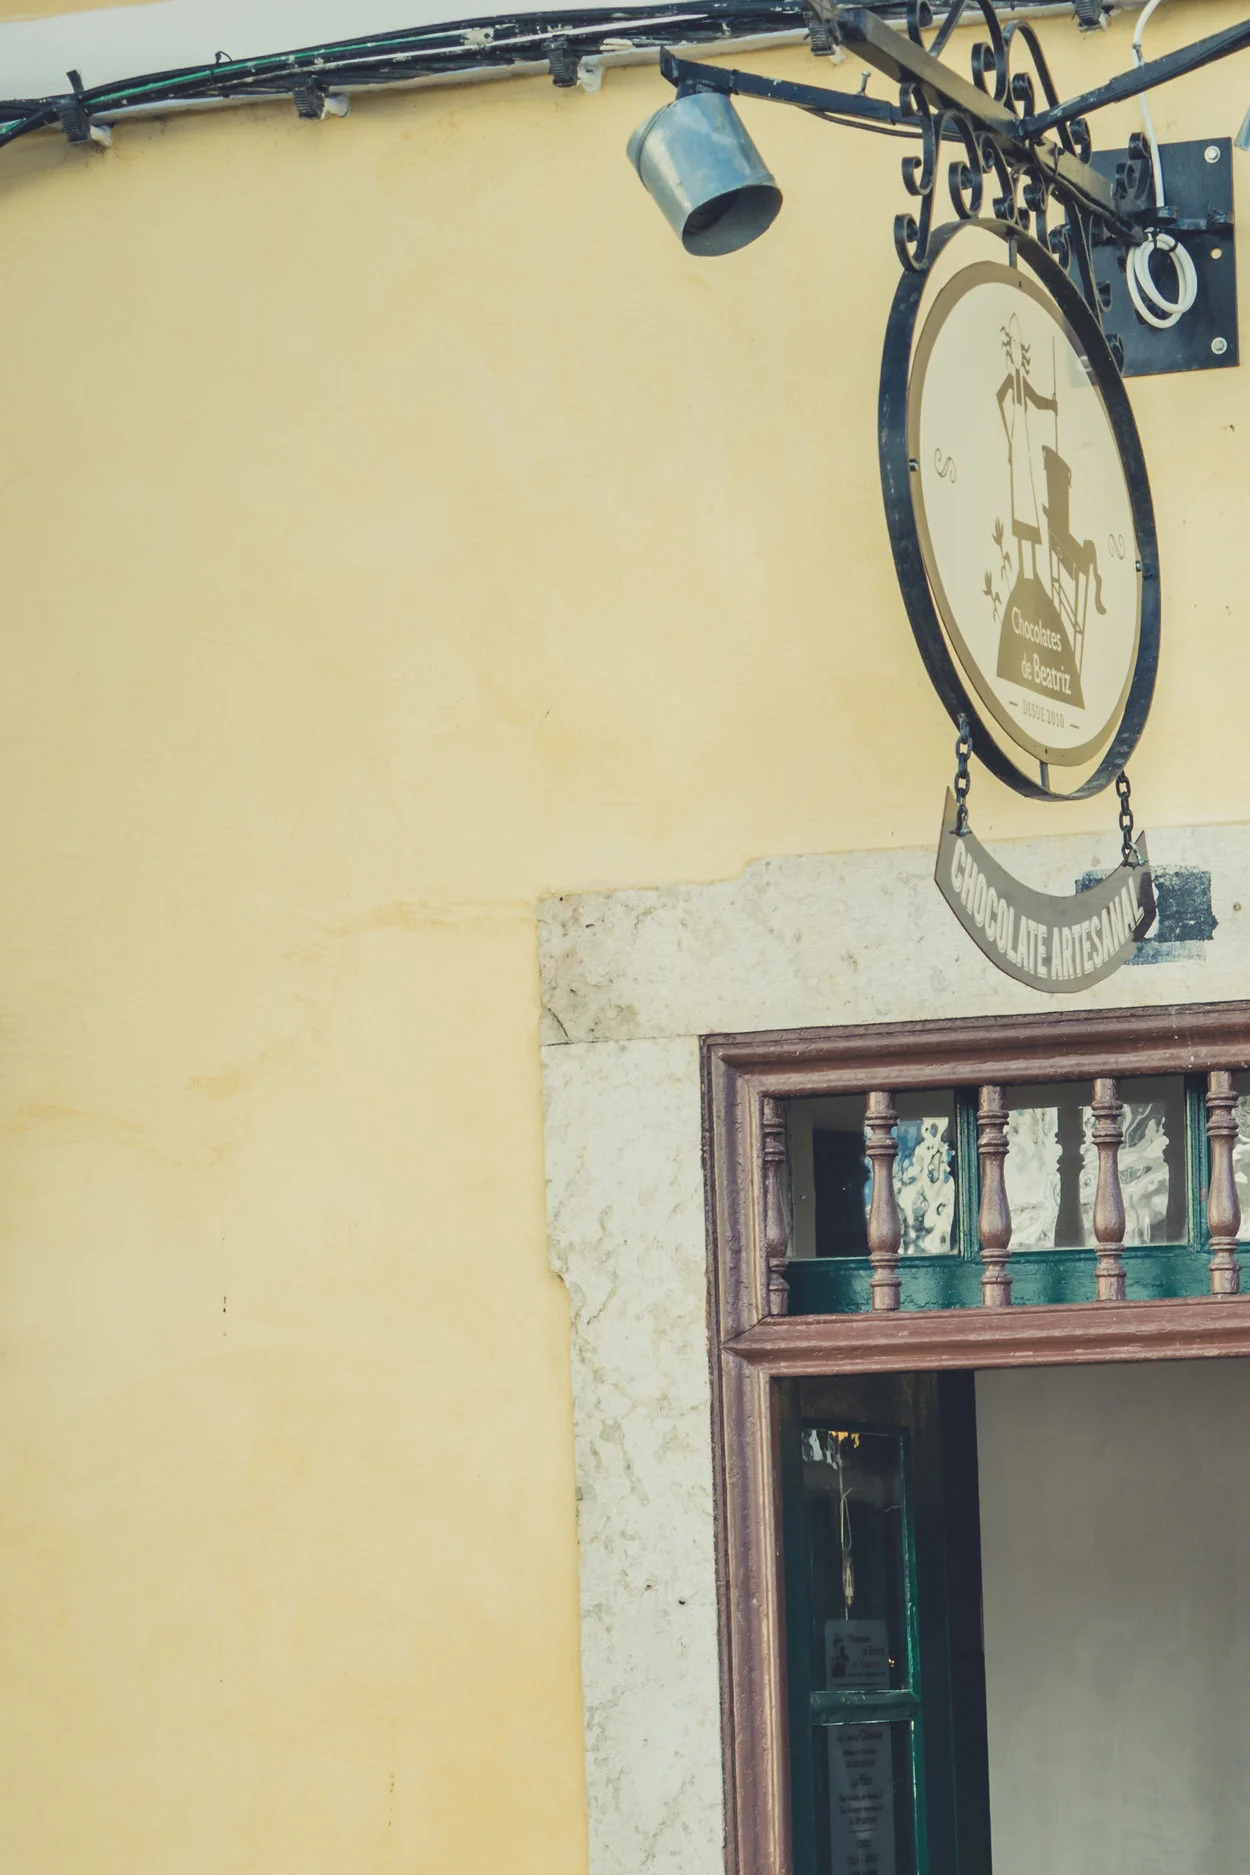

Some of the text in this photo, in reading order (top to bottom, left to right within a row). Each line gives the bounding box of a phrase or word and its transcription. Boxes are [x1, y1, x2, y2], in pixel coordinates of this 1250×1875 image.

[1011, 606, 1062, 652] Chocolates
[1021, 652, 1072, 695] de Beatriz
[1022, 699, 1065, 729] DESDE 2010
[951, 838, 1146, 981] CHOCOLATE ARTESANAL
